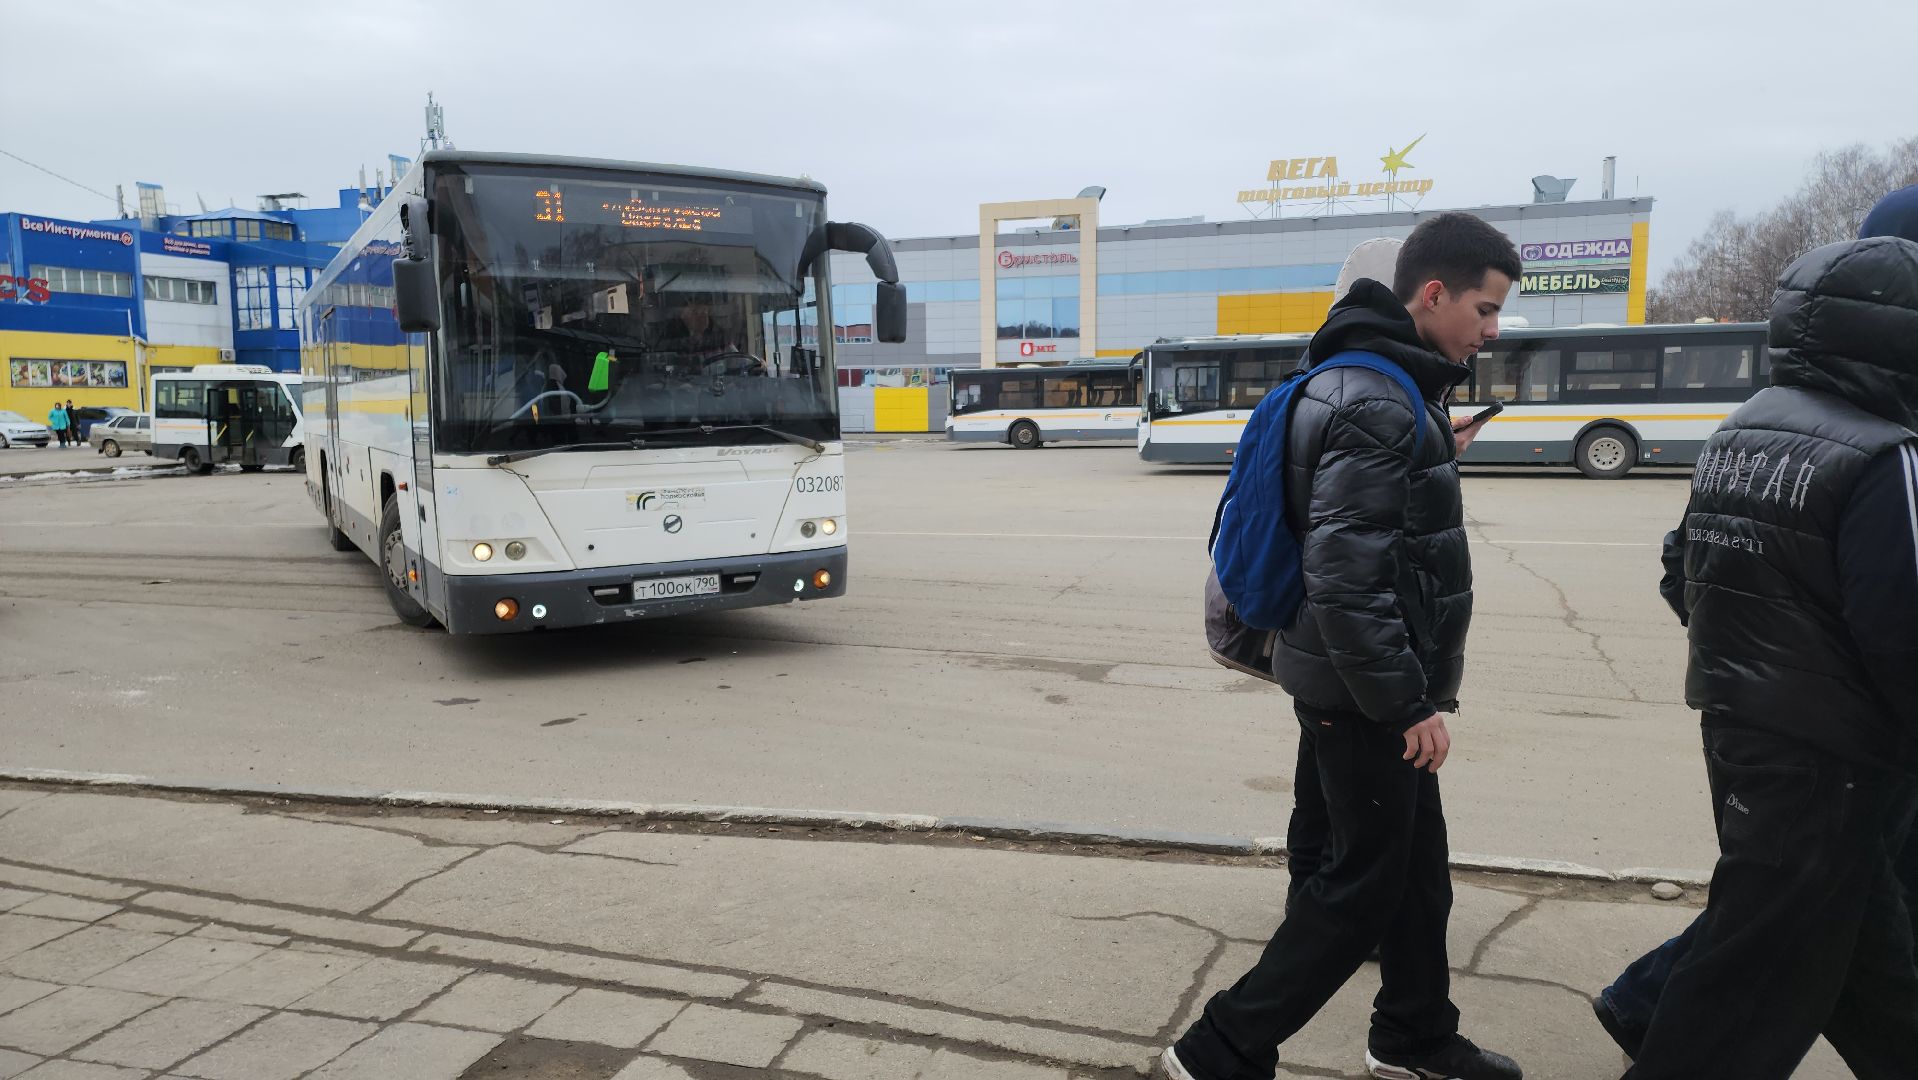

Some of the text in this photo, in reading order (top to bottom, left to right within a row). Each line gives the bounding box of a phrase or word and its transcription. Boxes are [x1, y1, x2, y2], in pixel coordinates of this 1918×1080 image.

[1267, 156, 1338, 181] ВЕГА
[1237, 179, 1434, 204] торговый центр
[1544, 240, 1630, 258] ОДЕЖДА
[1520, 273, 1601, 292] МЕБЕЛЬ
[695, 577, 715, 589] 790
[1727, 793, 1750, 815] Dime
